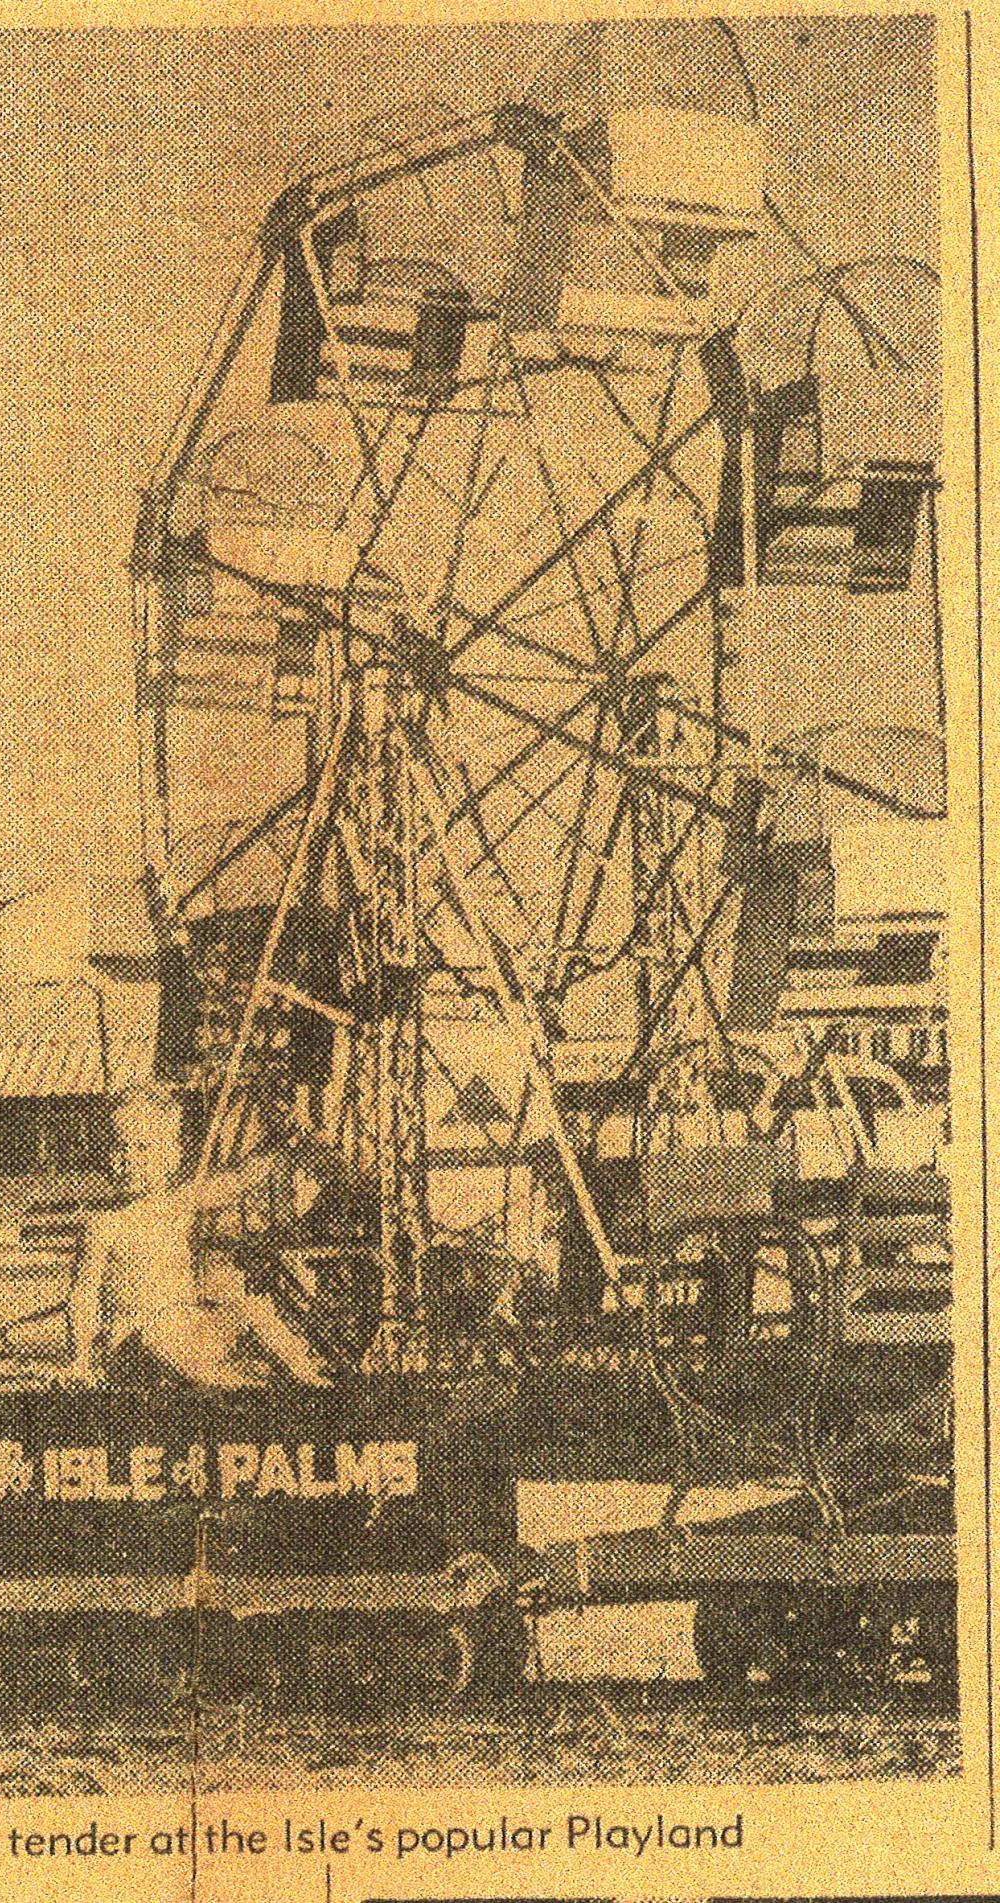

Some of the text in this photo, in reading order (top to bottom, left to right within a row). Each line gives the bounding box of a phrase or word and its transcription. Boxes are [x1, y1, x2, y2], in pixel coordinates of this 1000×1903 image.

[43, 1443, 167, 1502] ISLE
[172, 1442, 207, 1498] of
[217, 1440, 419, 1501] PALMS
